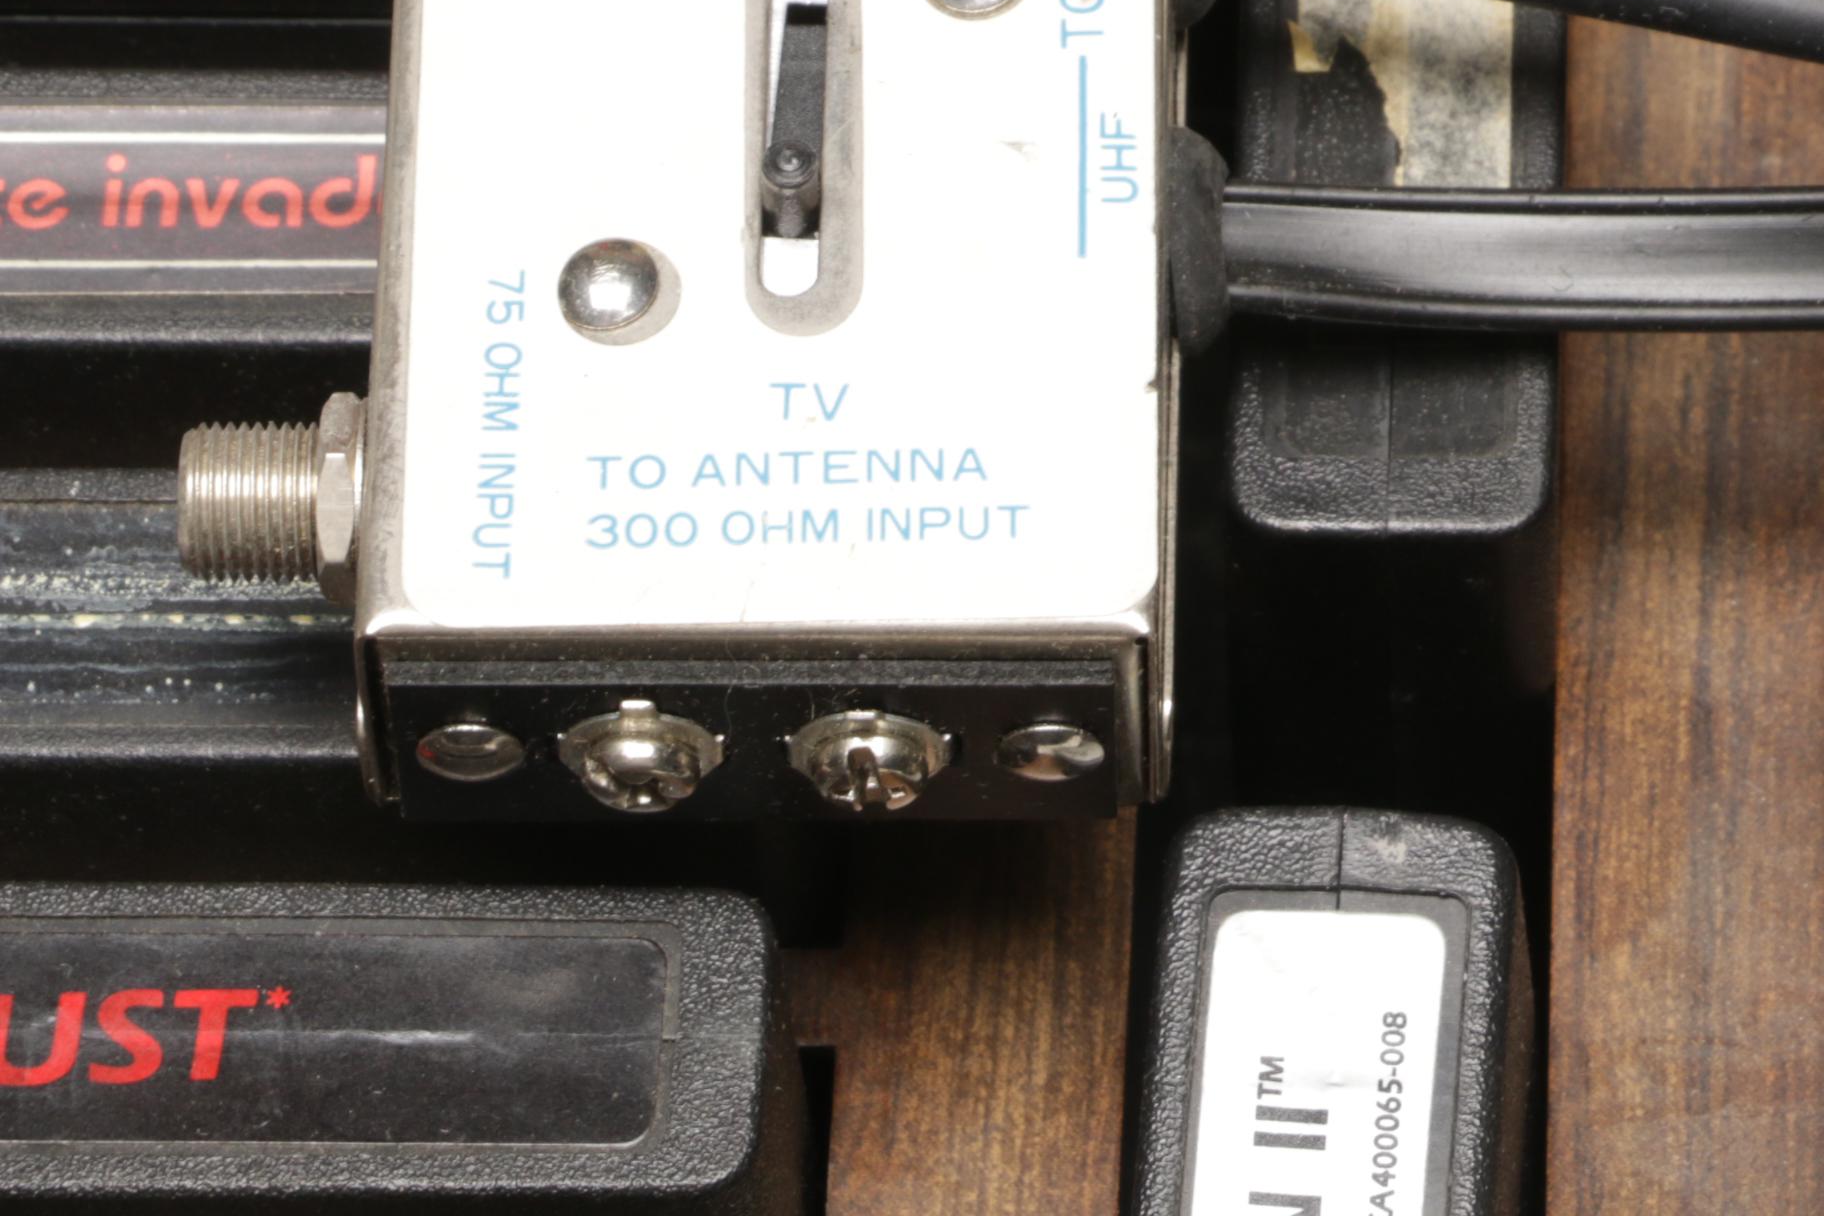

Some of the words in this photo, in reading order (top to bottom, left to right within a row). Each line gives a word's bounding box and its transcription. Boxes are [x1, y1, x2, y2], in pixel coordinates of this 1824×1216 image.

[1099, 112, 1139, 204] UHF
[103, 153, 384, 230] invad
[485, 269, 526, 324] 75
[482, 342, 523, 432] OHM
[769, 382, 849, 421] TV
[586, 453, 667, 490] TO
[691, 447, 988, 488] ANTENNA
[470, 452, 517, 579] INPUT
[585, 511, 699, 550] 300
[719, 508, 840, 546] OHM
[866, 504, 1030, 542] INPUT
